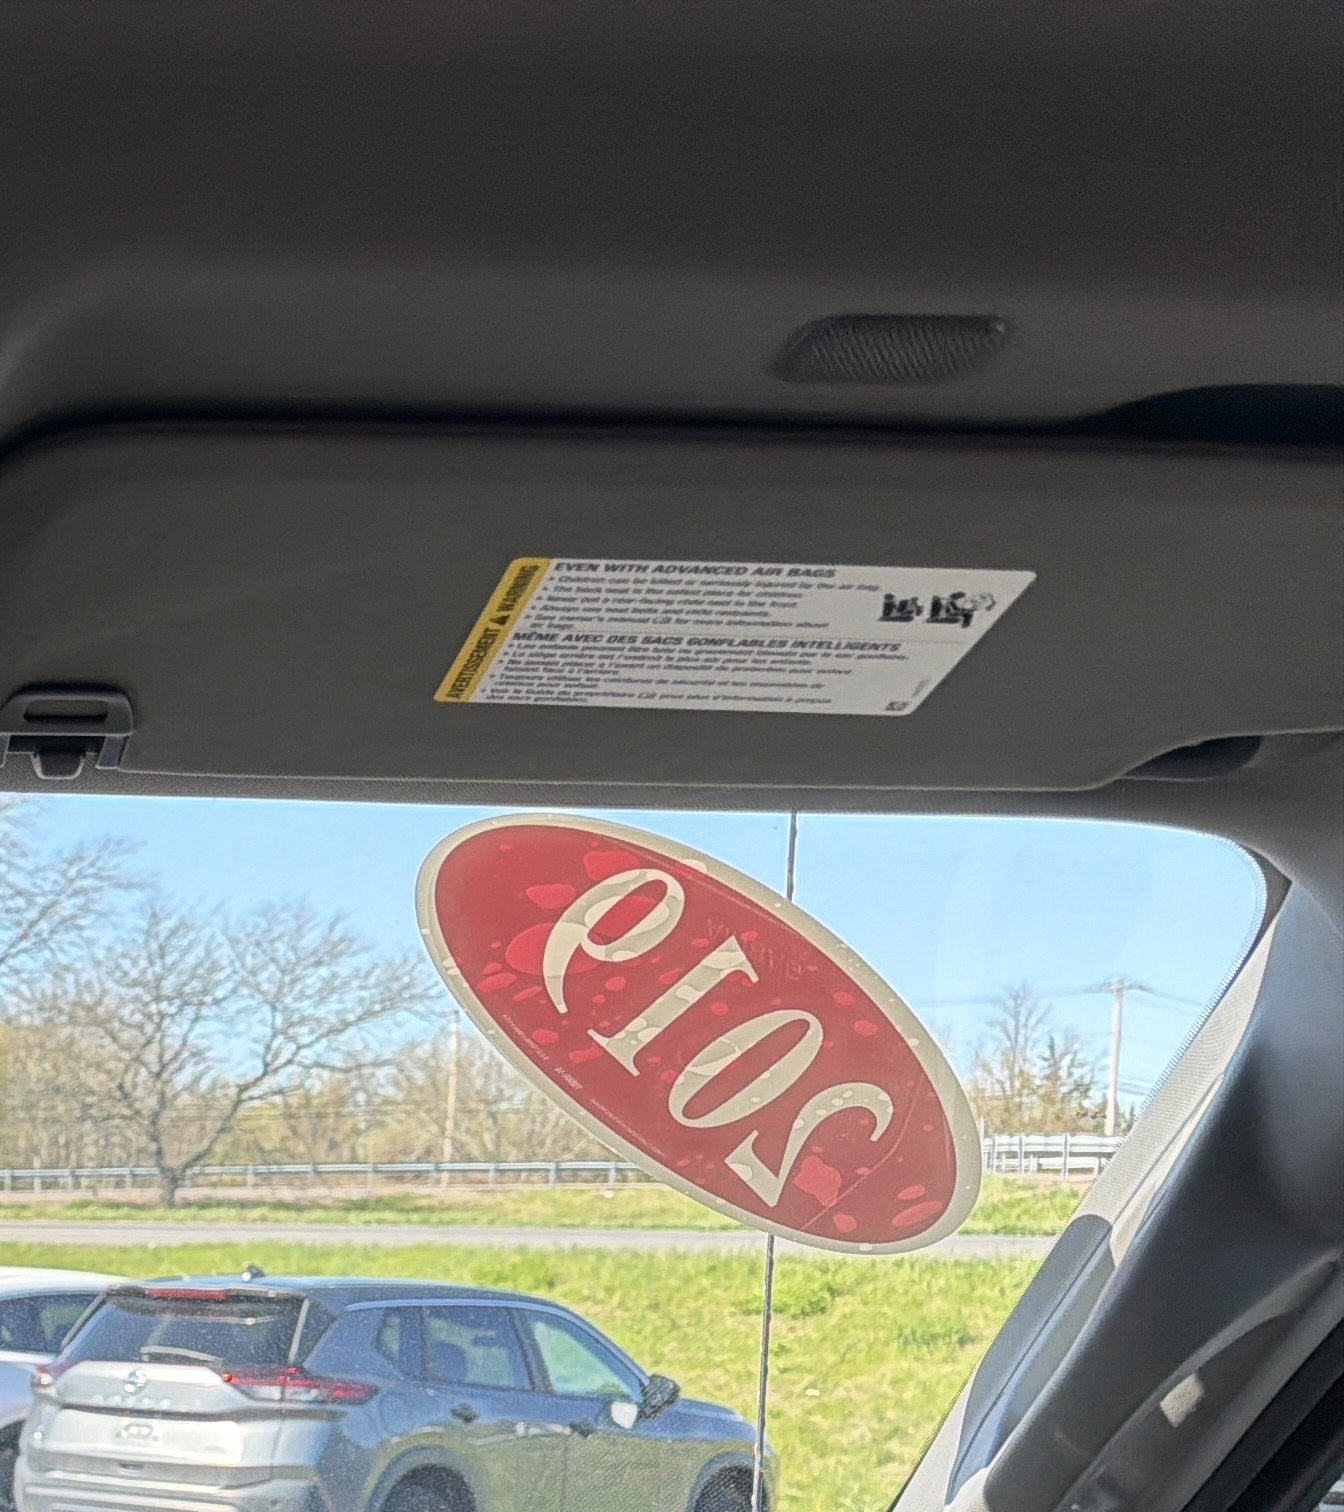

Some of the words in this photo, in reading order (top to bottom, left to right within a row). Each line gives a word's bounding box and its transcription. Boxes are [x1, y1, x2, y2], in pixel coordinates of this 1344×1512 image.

[554, 562, 601, 572] EVEN
[604, 563, 650, 573] WITH
[651, 564, 748, 576] ADVANCED
[750, 567, 784, 576] AIR
[786, 568, 837, 578] BAGS
[512, 632, 560, 642] MÊME
[562, 634, 604, 643] AVEC
[606, 635, 638, 644] DES
[641, 636, 682, 645] SACS
[686, 637, 790, 648] GONFLABLES
[790, 640, 902, 652] INTELLIGENTS
